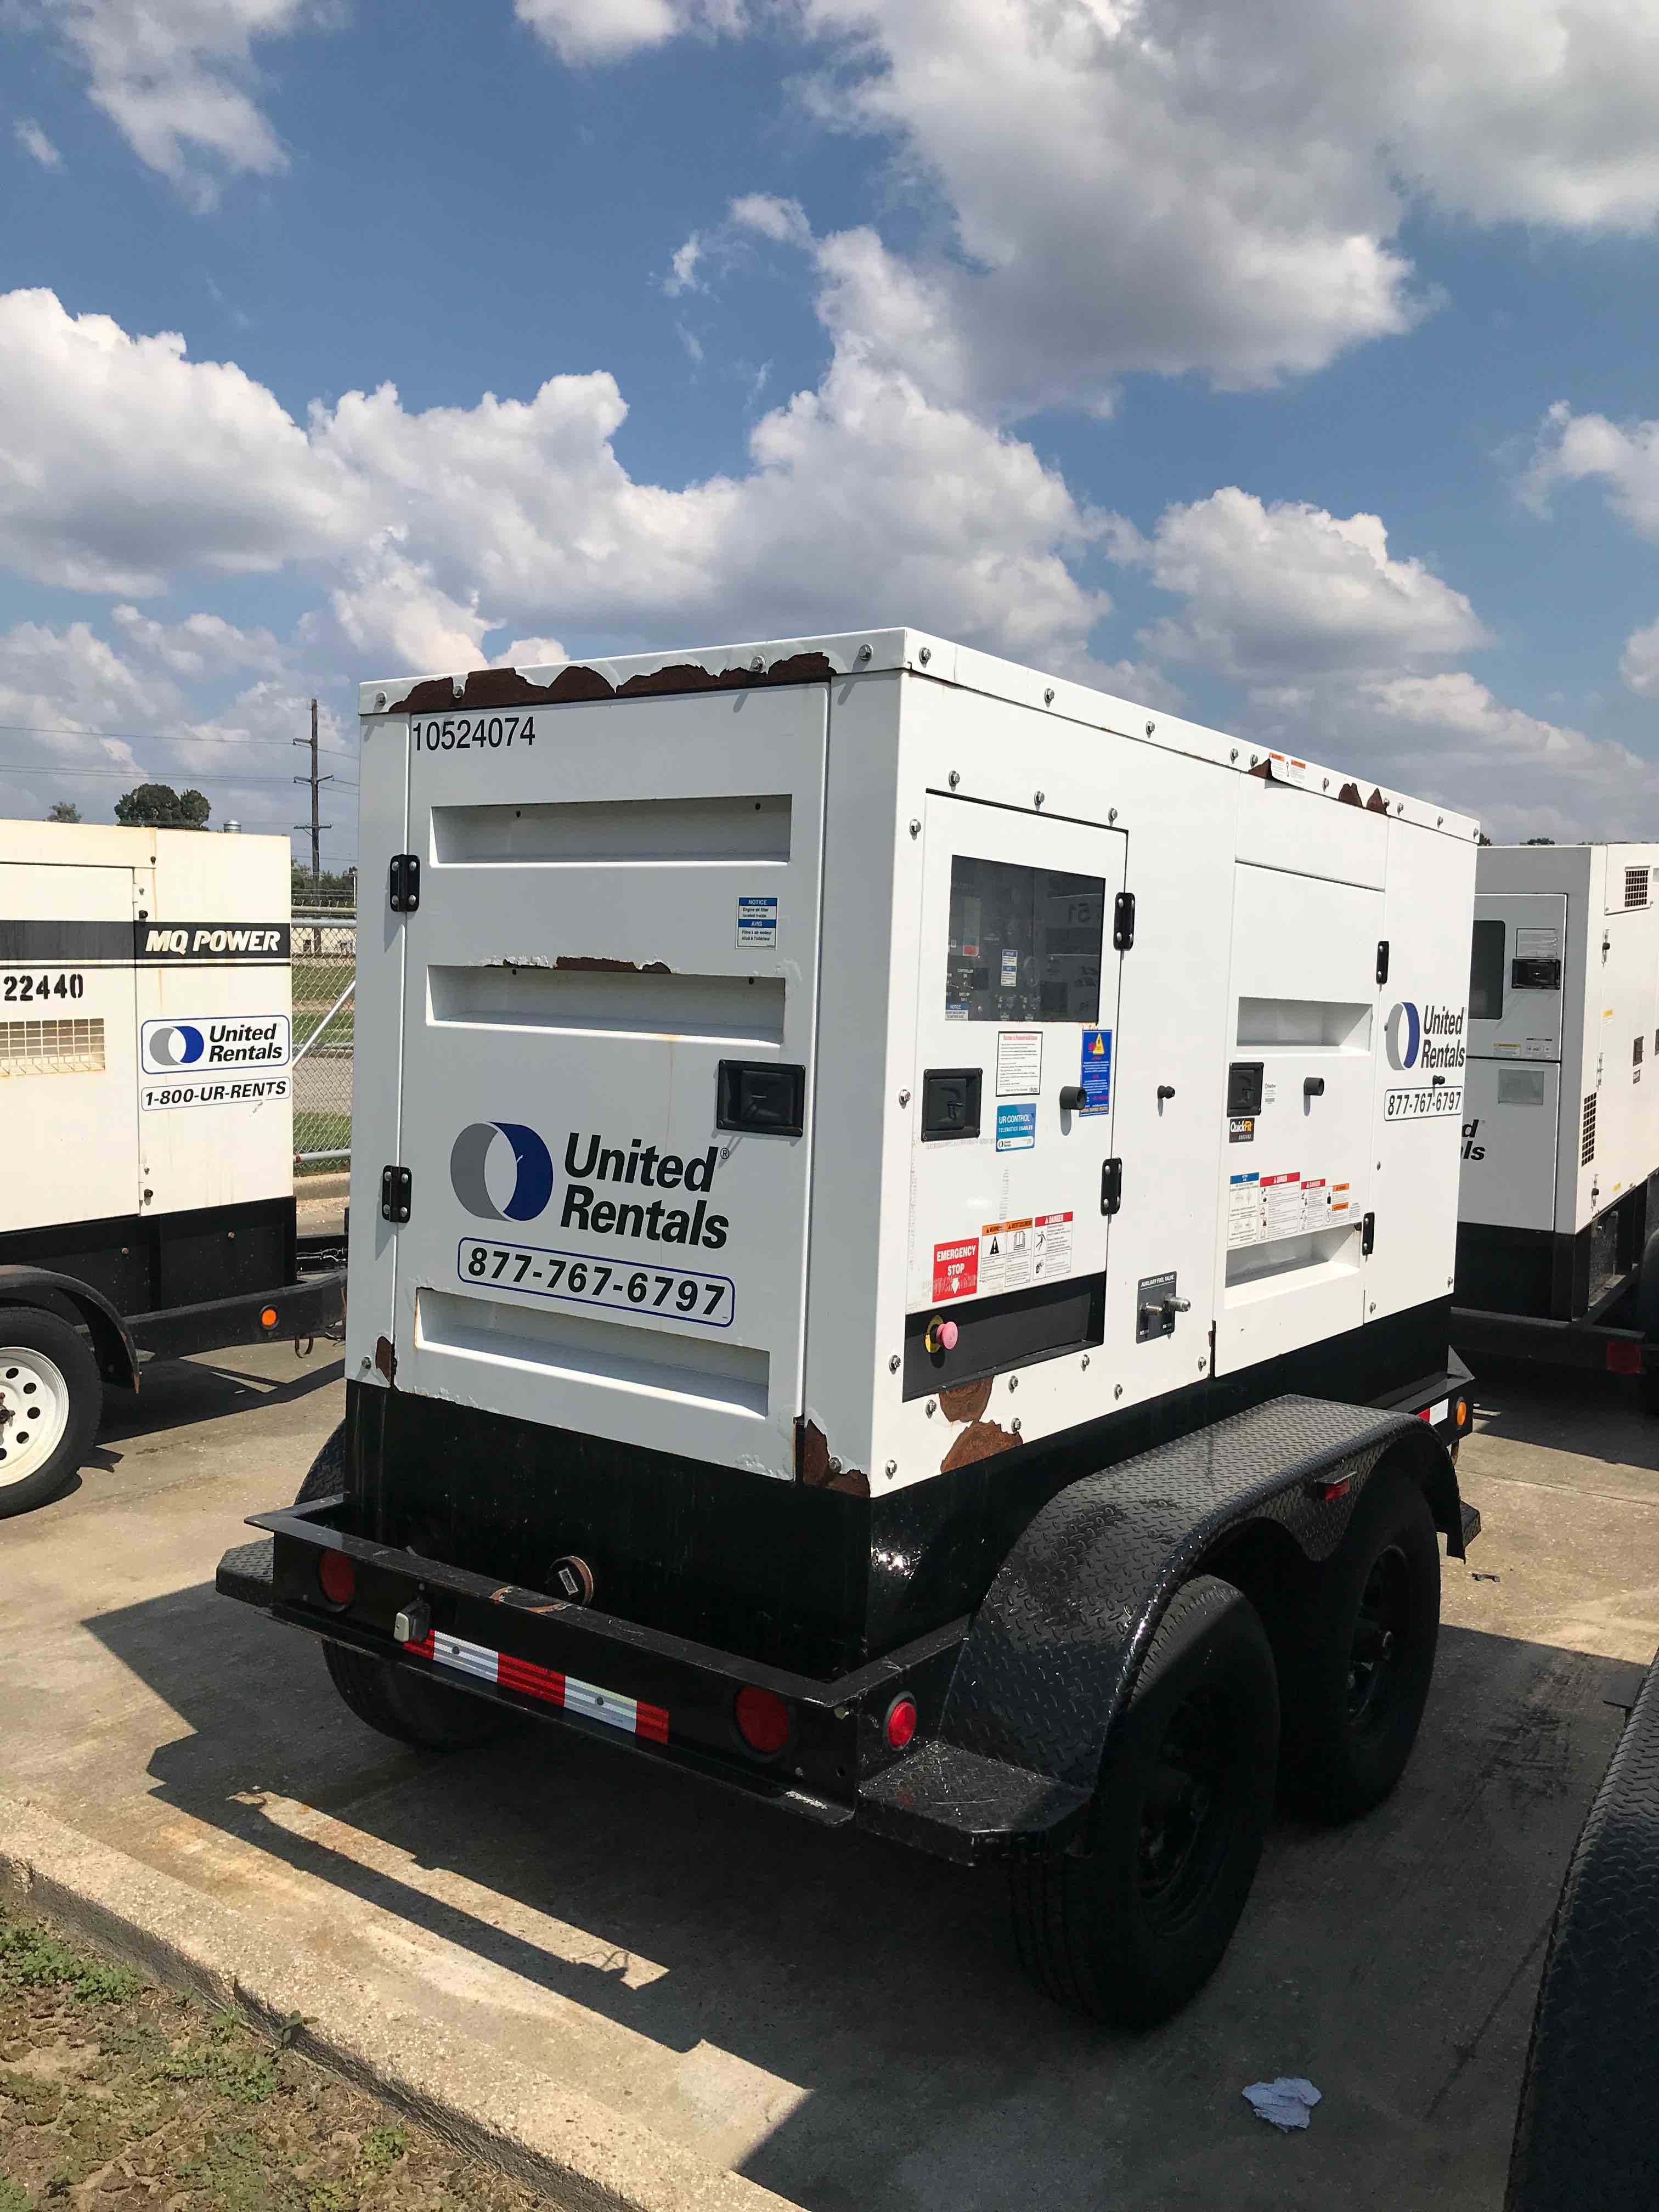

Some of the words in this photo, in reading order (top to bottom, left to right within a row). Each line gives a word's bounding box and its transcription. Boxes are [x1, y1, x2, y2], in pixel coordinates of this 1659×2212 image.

[413, 716, 535, 751] 10524074
[145, 930, 189, 955] MQ
[193, 930, 281, 952] POWER
[3, 974, 84, 1001] 22440
[1423, 1005, 1464, 1035] United
[209, 1023, 276, 1043] United
[208, 1042, 282, 1063] Rentals
[1420, 1039, 1465, 1069] Rentals
[145, 1081, 286, 1106] 1-800-UR-RENTS
[1387, 1092, 1461, 1116] 877-767-6797
[1007, 1114, 1030, 1123] CONTROL
[564, 1132, 719, 1193] United
[560, 1184, 730, 1249] Rentals
[936, 1244, 977, 1262] EMERGENCY
[468, 1247, 725, 1316] 877-767-6797
[947, 1263, 965, 1276] STOP
